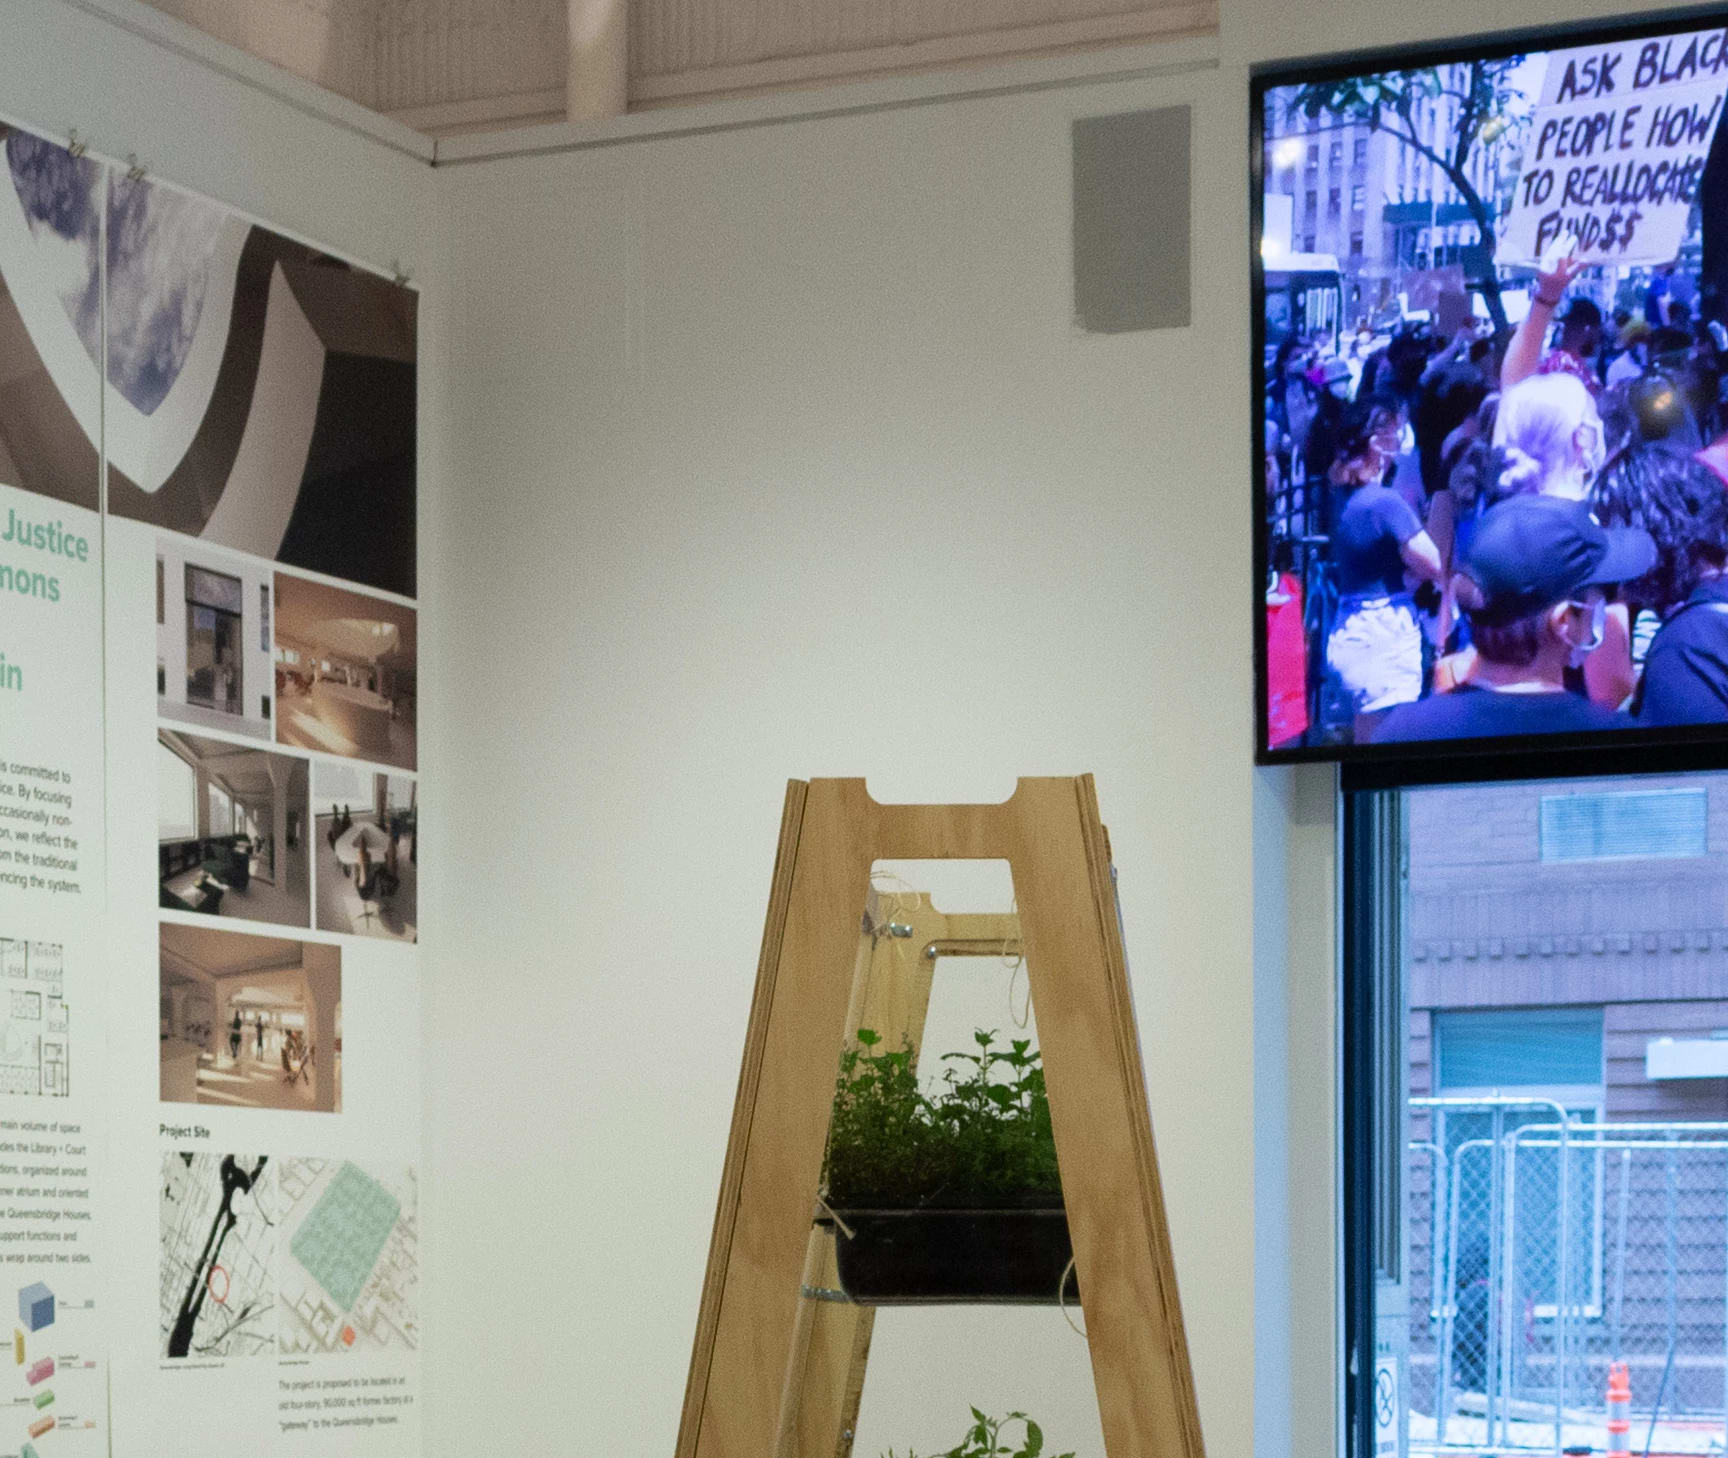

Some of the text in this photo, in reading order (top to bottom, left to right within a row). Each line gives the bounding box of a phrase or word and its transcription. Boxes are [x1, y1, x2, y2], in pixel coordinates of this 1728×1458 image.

[1557, 52, 1621, 104] ASK
[1536, 95, 1722, 161] PEOPLE HOW
[1524, 168, 1554, 208] TO
[2, 508, 88, 562] Justice
[0, 653, 22, 691] in
[0, 761, 8, 773] is
[9, 763, 60, 783] committed
[61, 771, 71, 785] to
[18, 783, 31, 802] By
[33, 786, 72, 810] focusing
